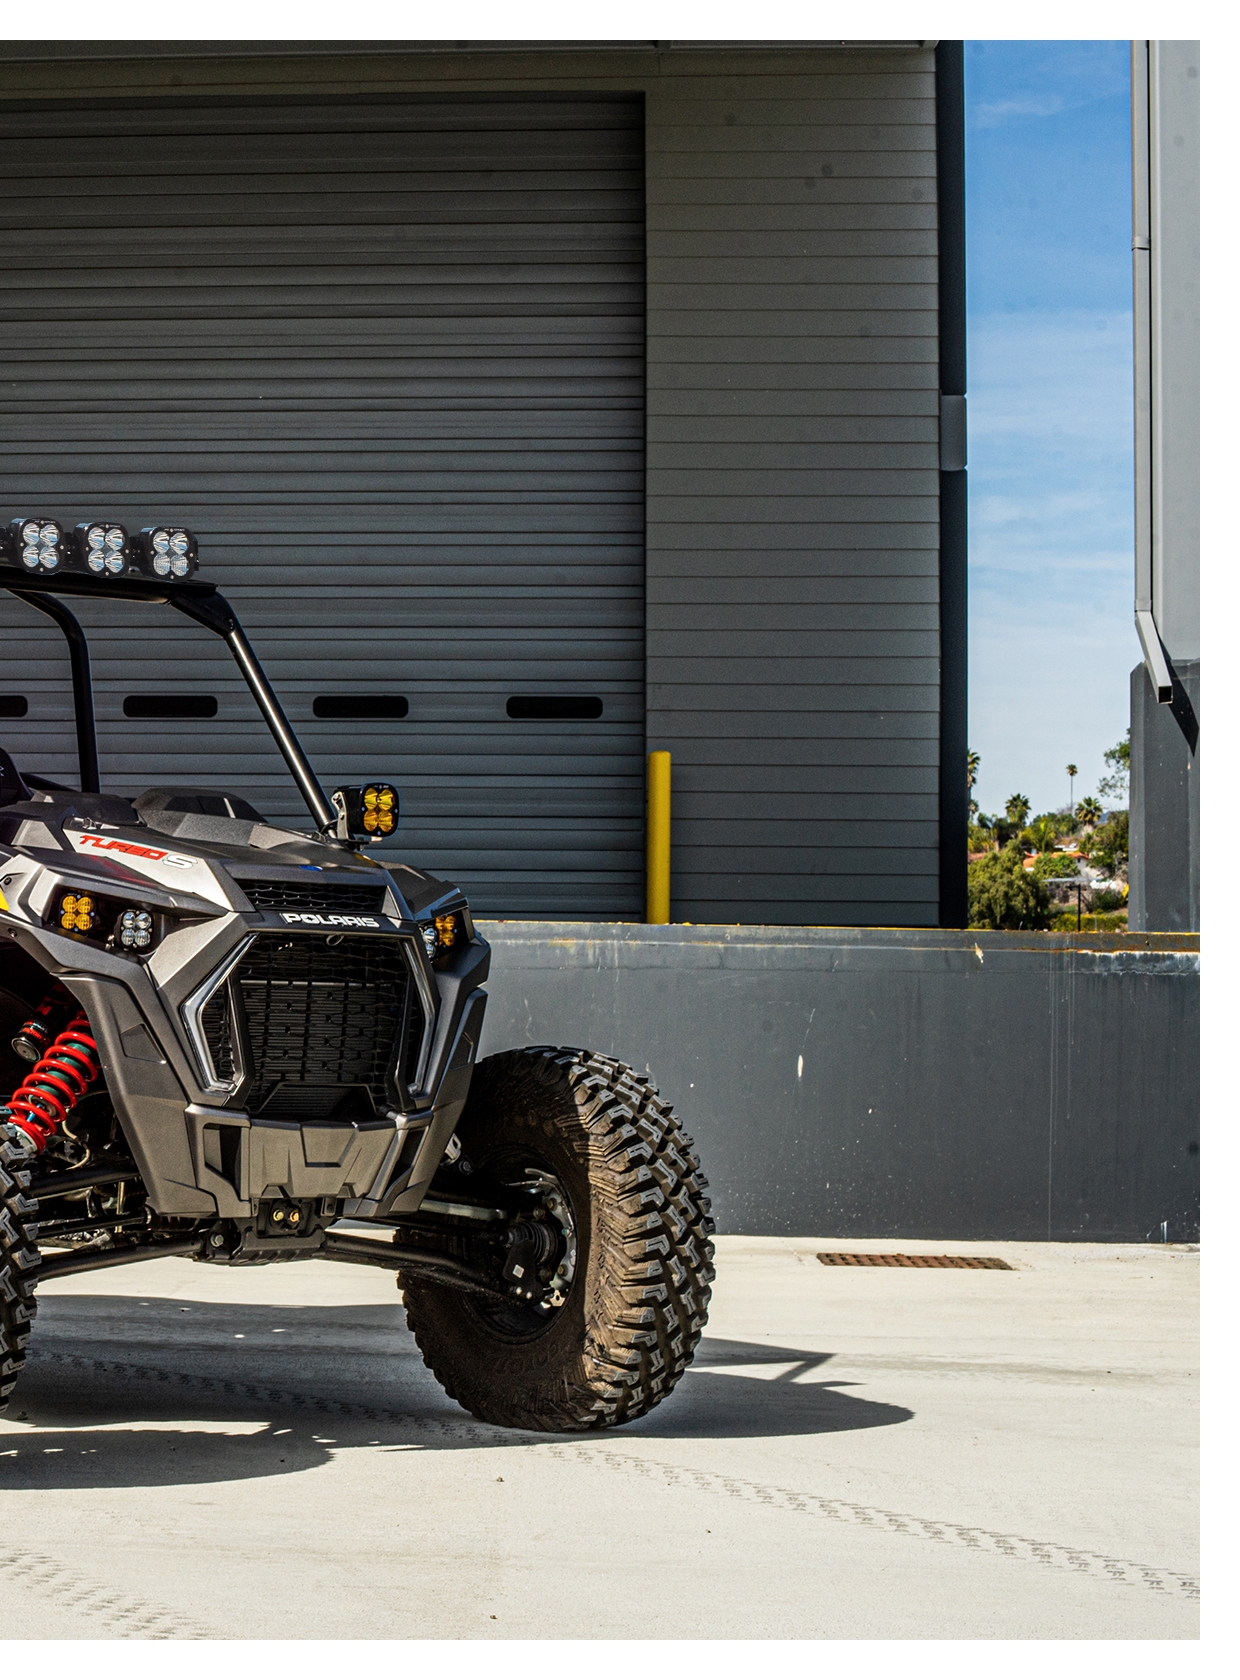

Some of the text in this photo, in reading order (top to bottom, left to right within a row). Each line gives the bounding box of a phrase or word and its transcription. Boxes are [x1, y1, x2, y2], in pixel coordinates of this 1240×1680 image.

[80, 834, 199, 870] TURBO S
[280, 912, 380, 928] POLARIS
